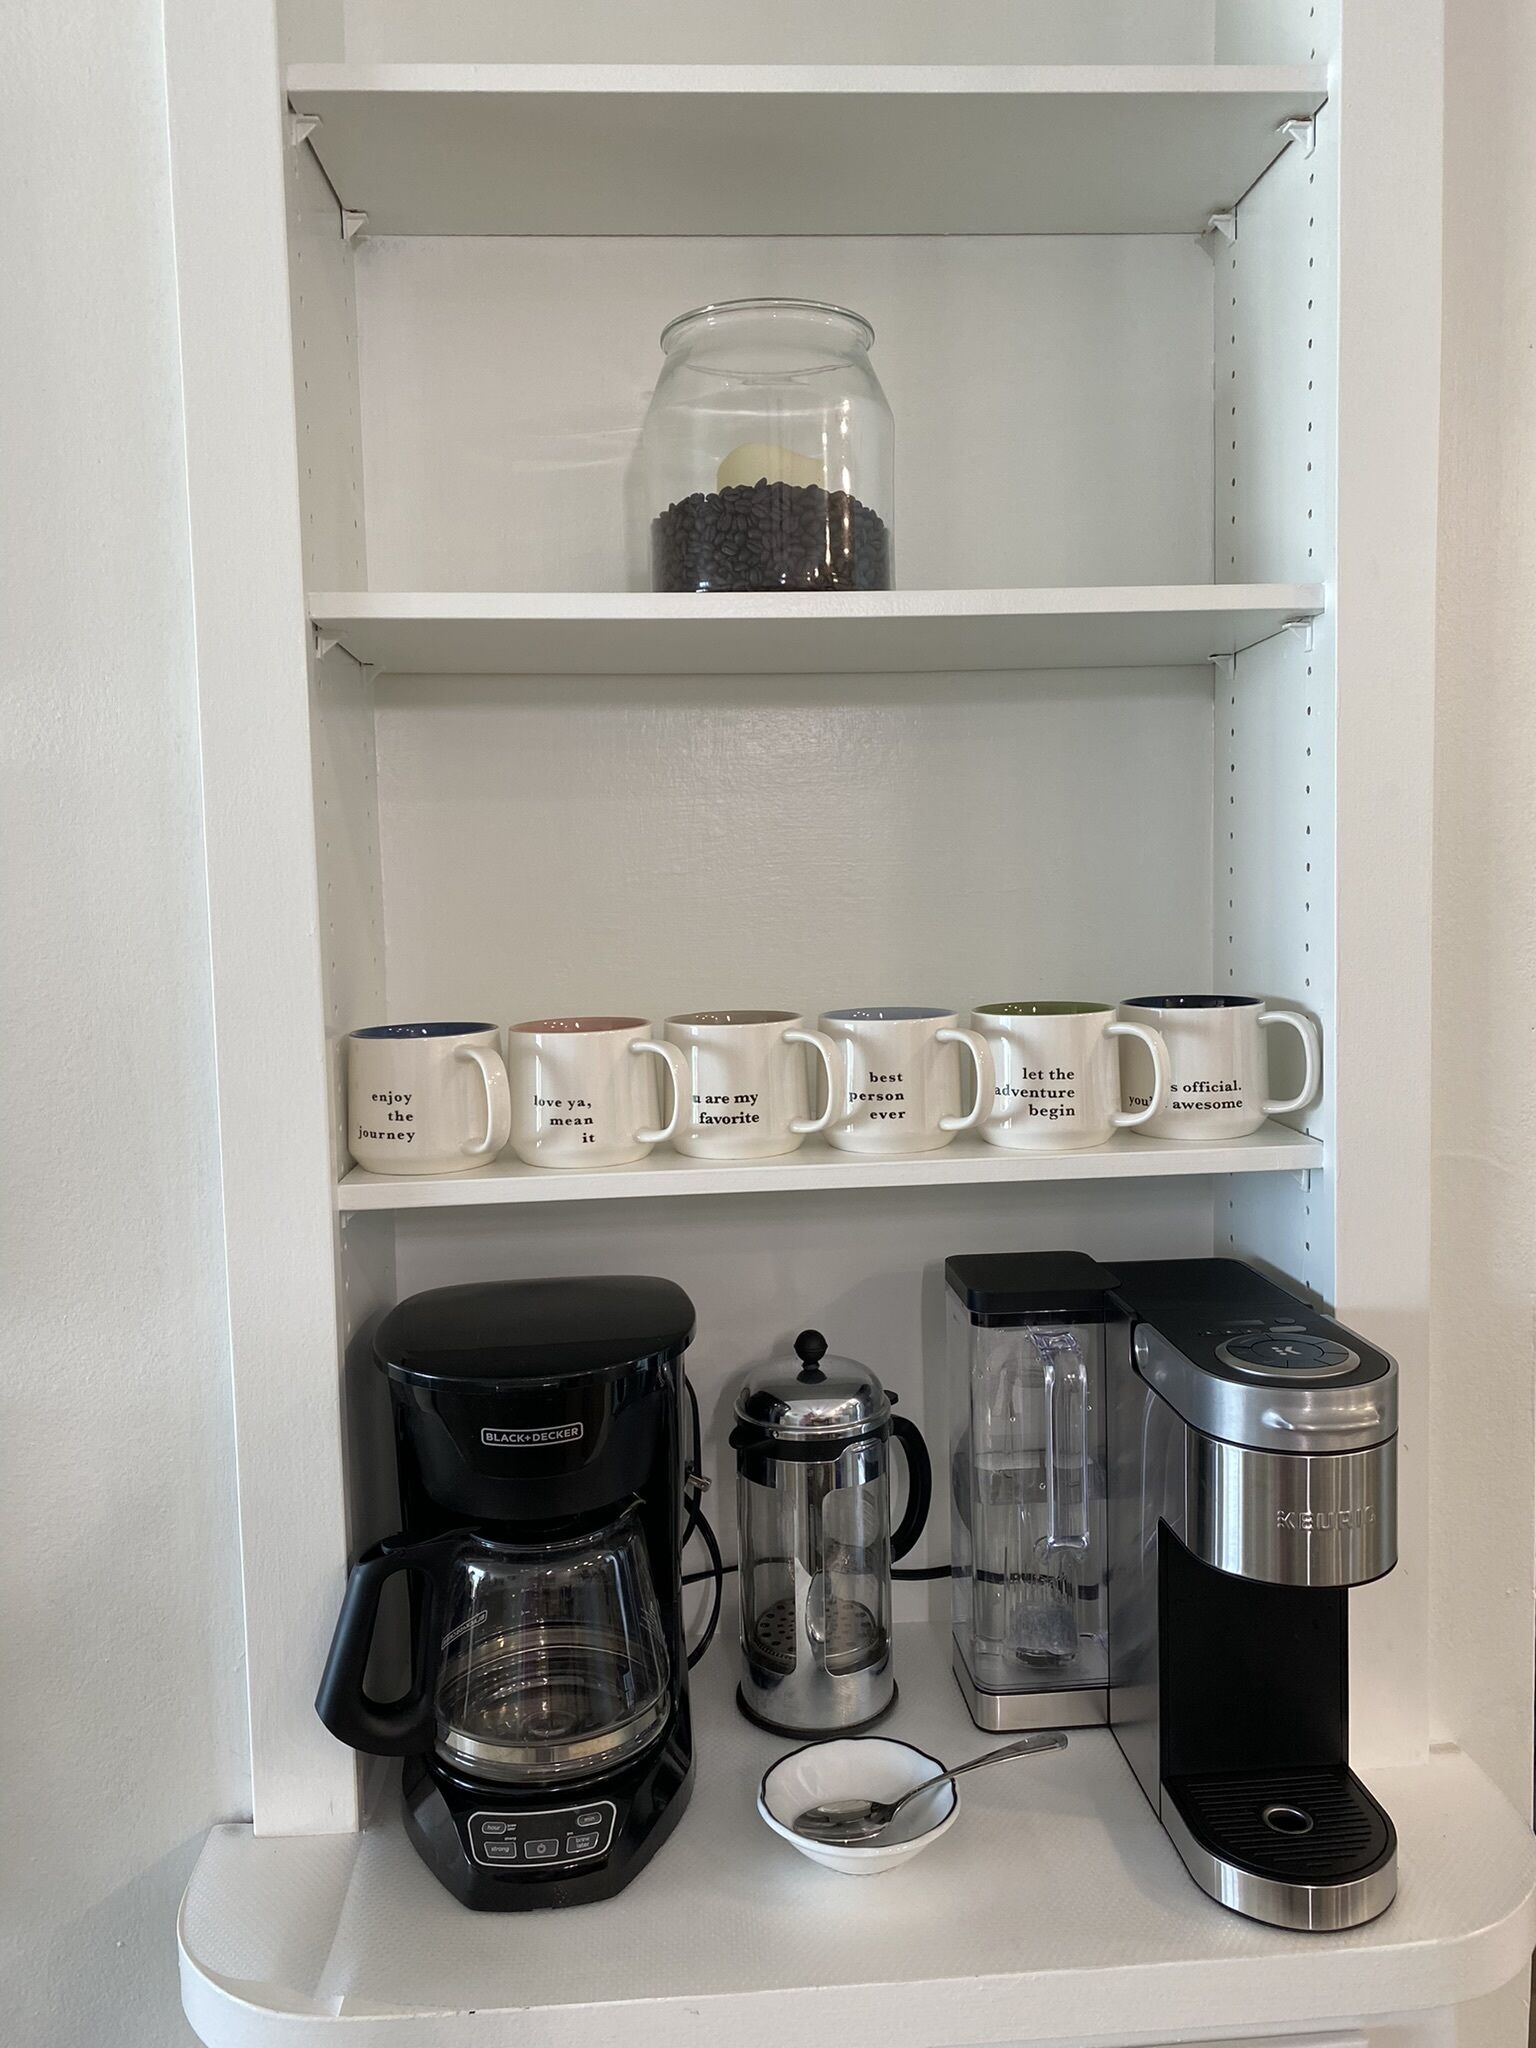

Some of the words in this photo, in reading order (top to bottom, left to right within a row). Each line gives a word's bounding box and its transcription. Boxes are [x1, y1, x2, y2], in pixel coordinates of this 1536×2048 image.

[869, 1072, 903, 1082] best
[1022, 1068, 1043, 1079] let
[1049, 1068, 1075, 1079] the
[995, 1084, 1075, 1098] adventure
[1182, 1080, 1242, 1092] official.
[372, 1091, 412, 1105] enjoy
[534, 1096, 562, 1107] love
[568, 1100, 592, 1110] ya,
[705, 1095, 729, 1104] are
[734, 1094, 758, 1106] my
[849, 1092, 904, 1102] person
[1172, 1099, 1243, 1109] awesome
[388, 1111, 414, 1121] the
[699, 1112, 760, 1124] favorite
[870, 1111, 906, 1119] ever
[1028, 1104, 1075, 1120] begin
[550, 1117, 593, 1125] mean
[358, 1126, 415, 1142] journey
[582, 1133, 595, 1143] it
[486, 1427, 579, 1443] BLACK+DECKER
